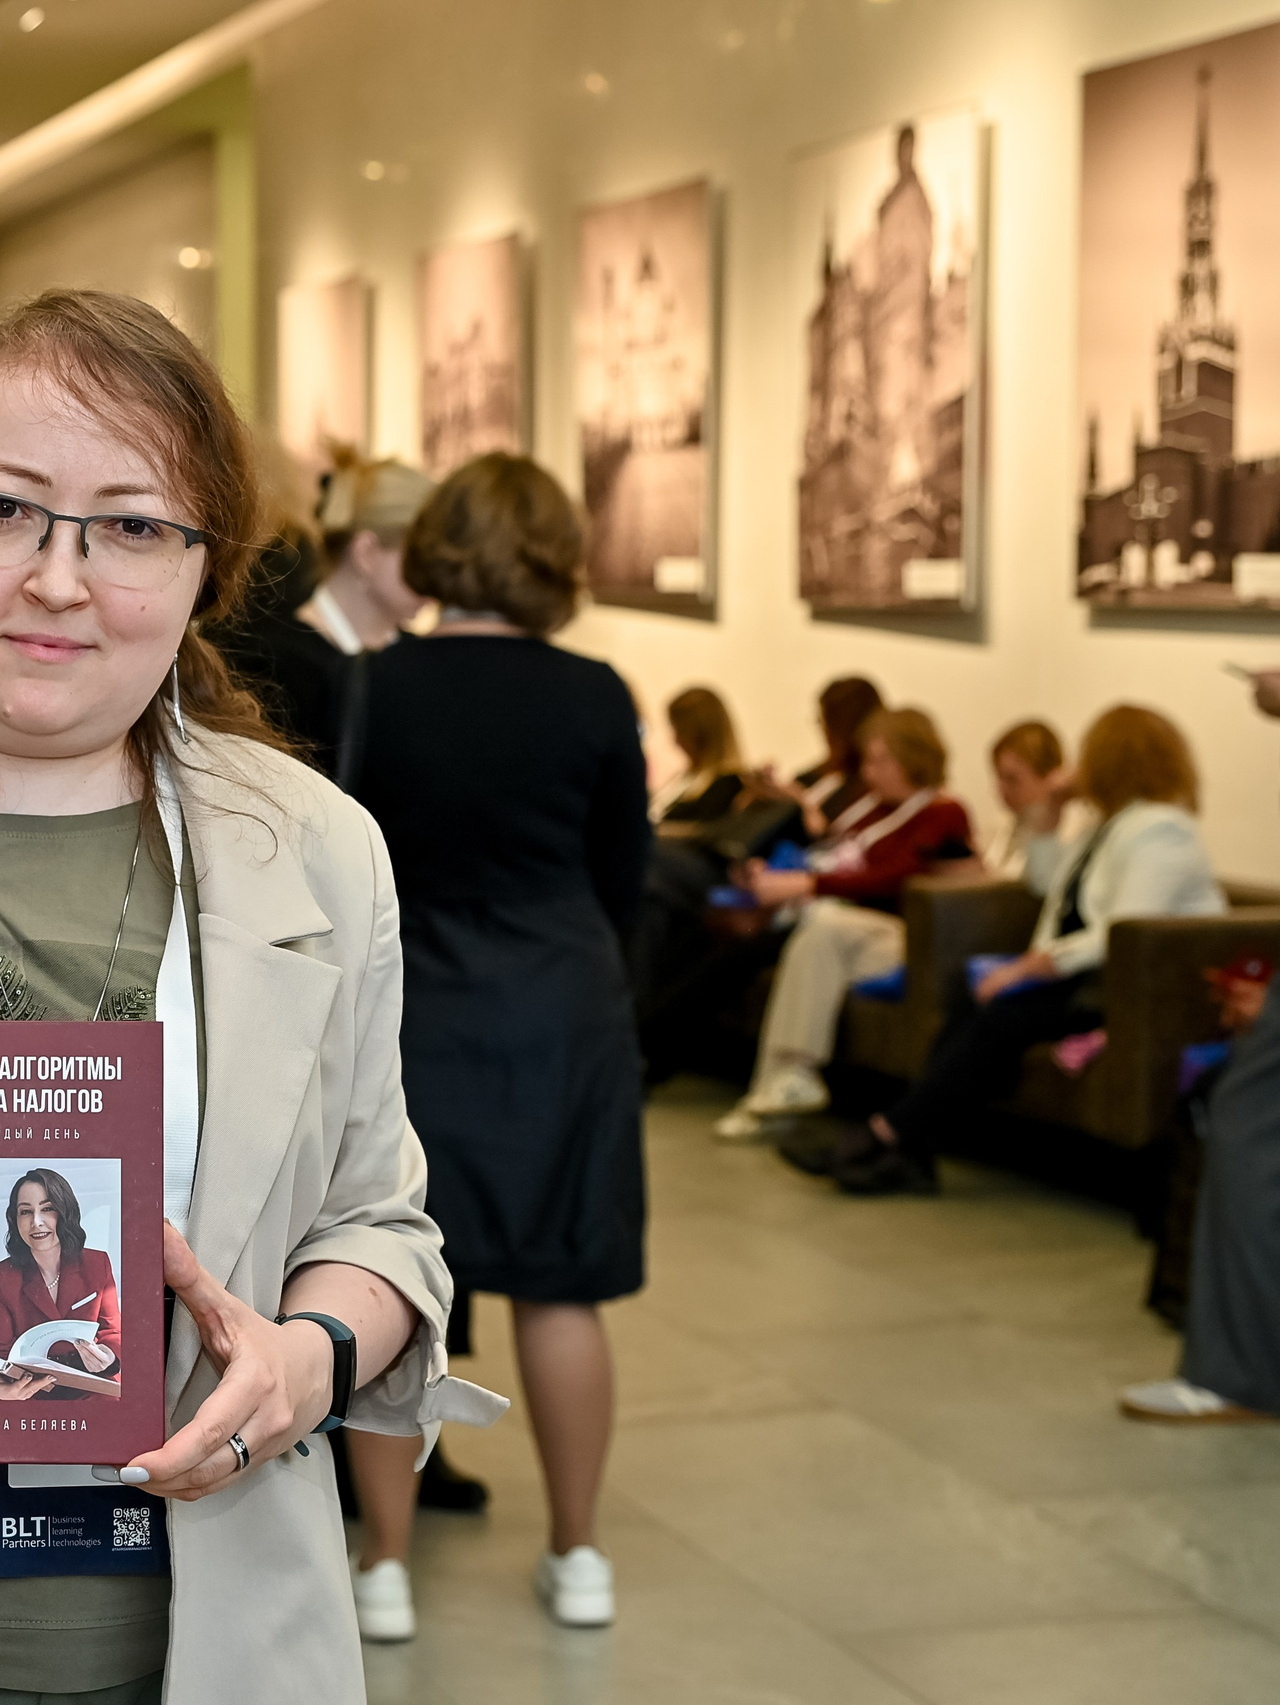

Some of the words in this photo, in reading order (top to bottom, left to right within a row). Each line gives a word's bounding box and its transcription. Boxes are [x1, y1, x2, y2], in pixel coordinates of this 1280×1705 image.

[13, 1089, 103, 1113] НАЛОГОВ
[43, 1128, 81, 1140] ДЕНЬ
[20, 1419, 87, 1431] БЕЛЯЕВА
[52, 1516, 85, 1524] business
[2, 1516, 46, 1538] BLT
[52, 1527, 83, 1537] learning
[2, 1538, 46, 1548] Partners
[52, 1538, 101, 1548] technologies
